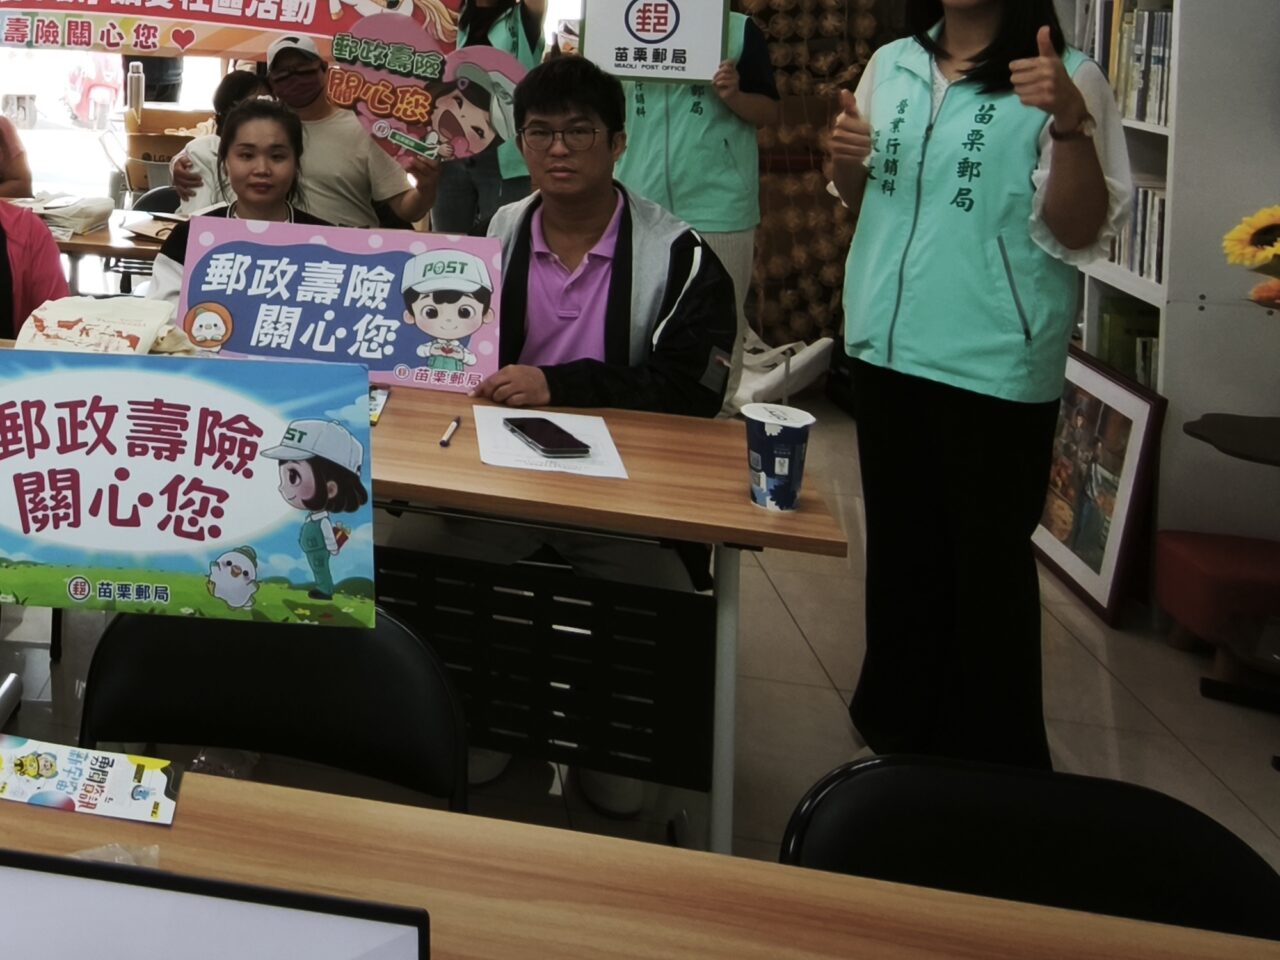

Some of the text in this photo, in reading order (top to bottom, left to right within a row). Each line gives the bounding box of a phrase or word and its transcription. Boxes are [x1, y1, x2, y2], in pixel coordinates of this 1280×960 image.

[333, 32, 443, 78] 郵政壽險
[614, 46, 687, 65] 苗栗郵局
[614, 62, 638, 70] MIAOLI
[641, 63, 659, 71] POST
[327, 68, 431, 122] 關心您
[881, 97, 909, 197] 營業行銷科
[949, 103, 997, 212] 苗栗郵局
[201, 252, 396, 310] 郵政壽險
[422, 260, 469, 278] POST
[249, 303, 402, 360] 關心您
[414, 367, 483, 387] 苗栗郵局
[13, 467, 230, 541] 關心您
[96, 582, 170, 603] 苗栗郵局
